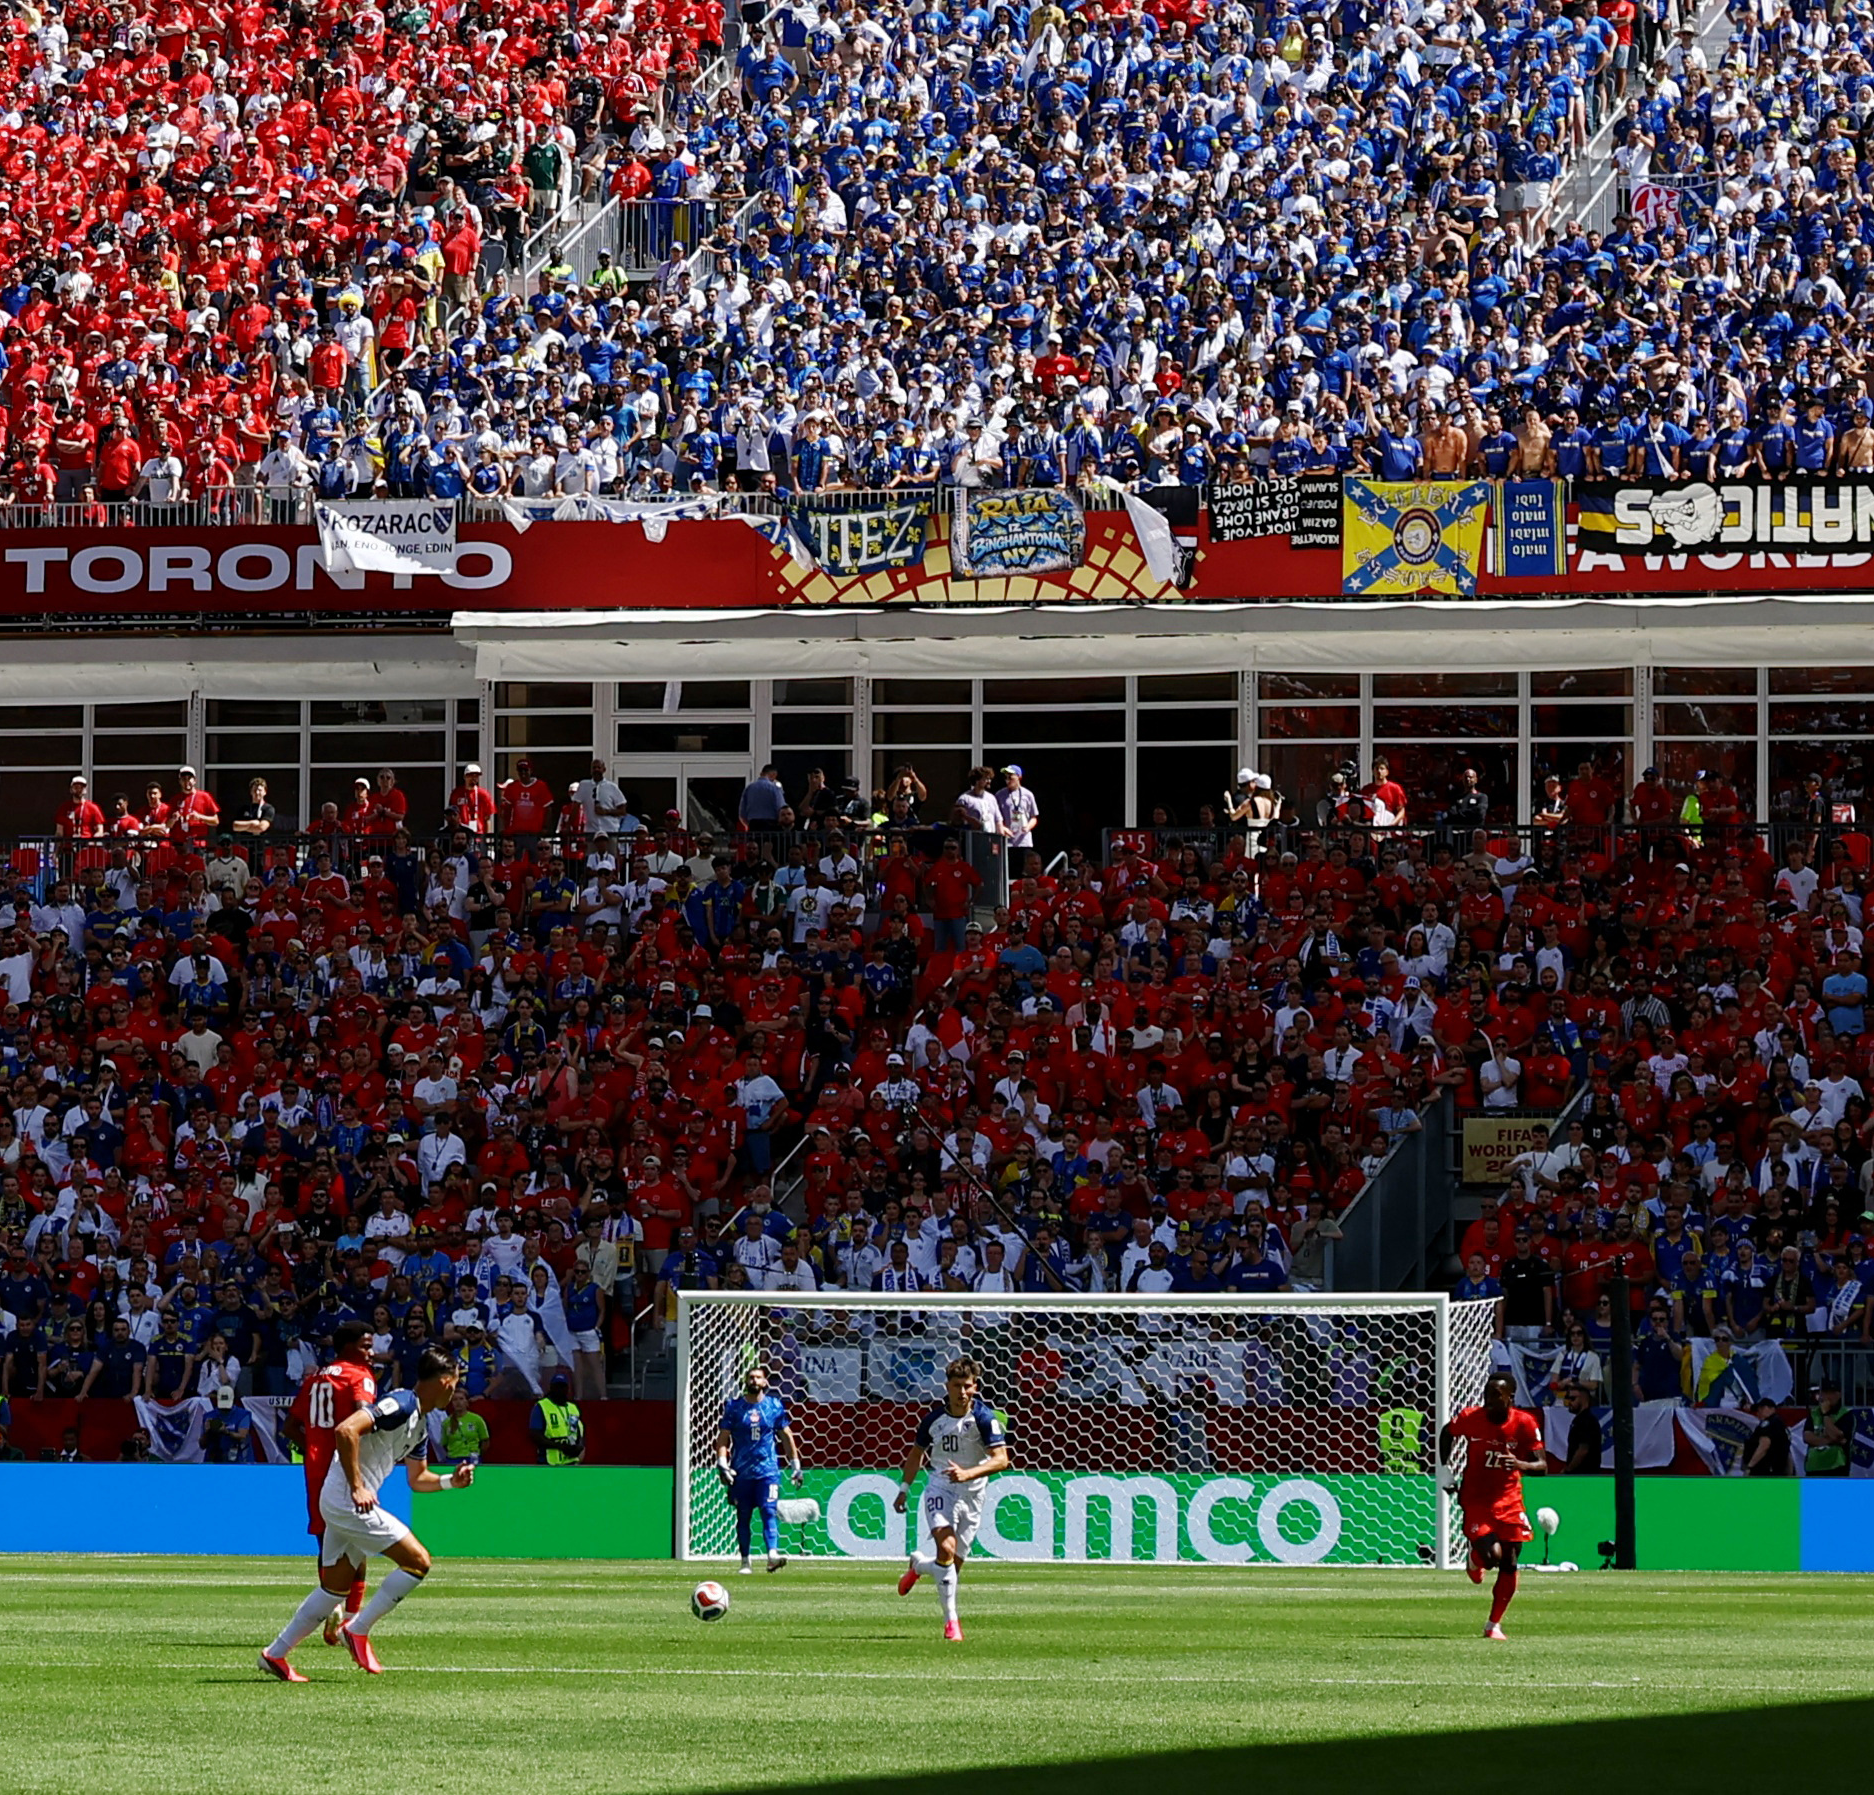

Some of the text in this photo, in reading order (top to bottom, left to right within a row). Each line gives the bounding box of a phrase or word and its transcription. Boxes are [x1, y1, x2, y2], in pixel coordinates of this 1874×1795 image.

[1213, 483, 1254, 499] MOME
[1256, 496, 1270, 509] SI
[1515, 493, 1543, 508] ludi
[331, 513, 432, 535] KOZARAC
[1216, 505, 1299, 528] GRANE LOME
[1512, 510, 1547, 524] malo
[1008, 523, 1022, 532] IZ
[1223, 527, 1264, 541] TVOJE
[1510, 527, 1550, 542] mladi
[425, 543, 453, 553] EDIN
[1512, 544, 1548, 558] malo
[1002, 546, 1037, 566] NY
[5, 541, 513, 591] TORONO
[1497, 1129, 1532, 1142] FIFA
[1468, 1144, 1526, 1157] WORLD
[308, 1381, 335, 1429] 10
[941, 1434, 959, 1453] 20
[927, 1495, 944, 1513] 20
[826, 1473, 1341, 1564] aamco
